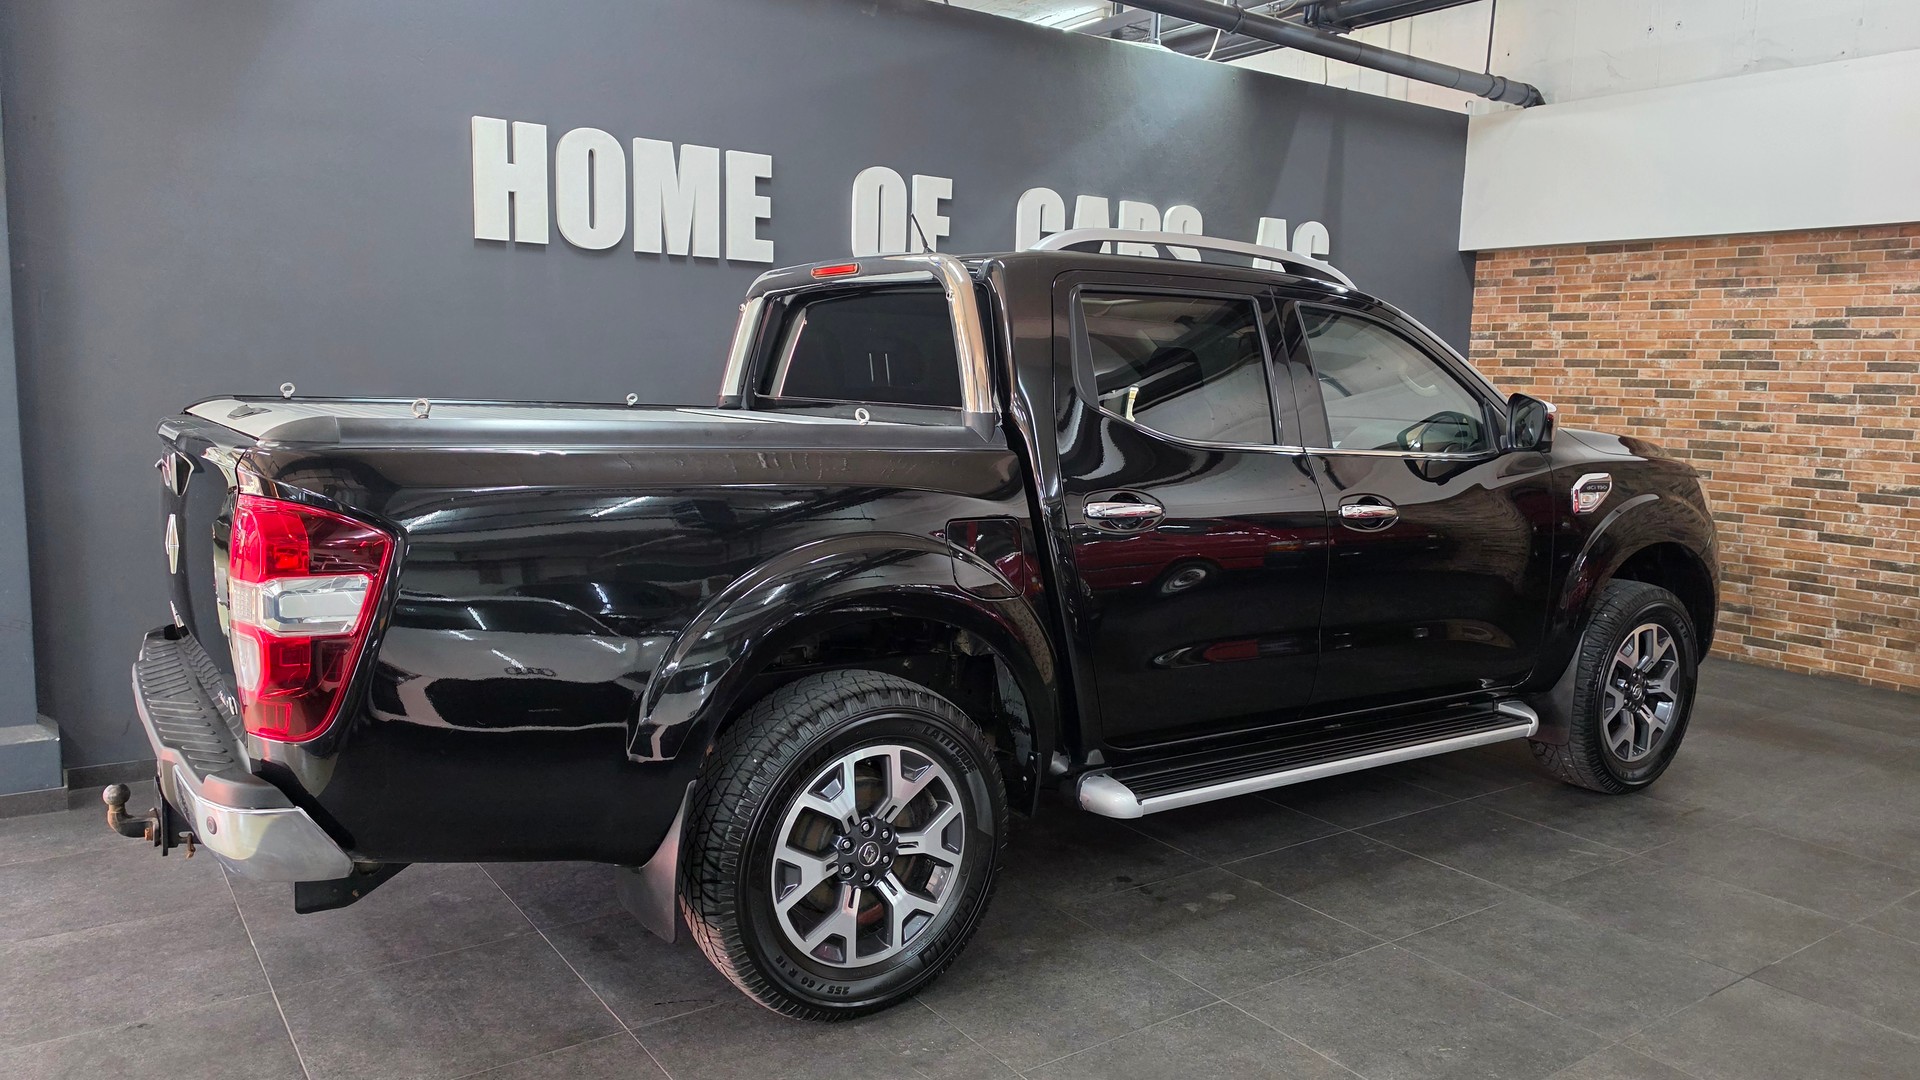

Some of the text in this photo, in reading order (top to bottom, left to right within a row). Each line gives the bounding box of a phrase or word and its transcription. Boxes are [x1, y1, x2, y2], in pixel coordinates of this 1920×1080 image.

[472, 115, 774, 263] HOME
[851, 166, 953, 258] OF
[921, 724, 978, 774] LATITUDE
[788, 967, 798, 978] R
[800, 977, 816, 988] 60
[827, 985, 851, 995] 255
